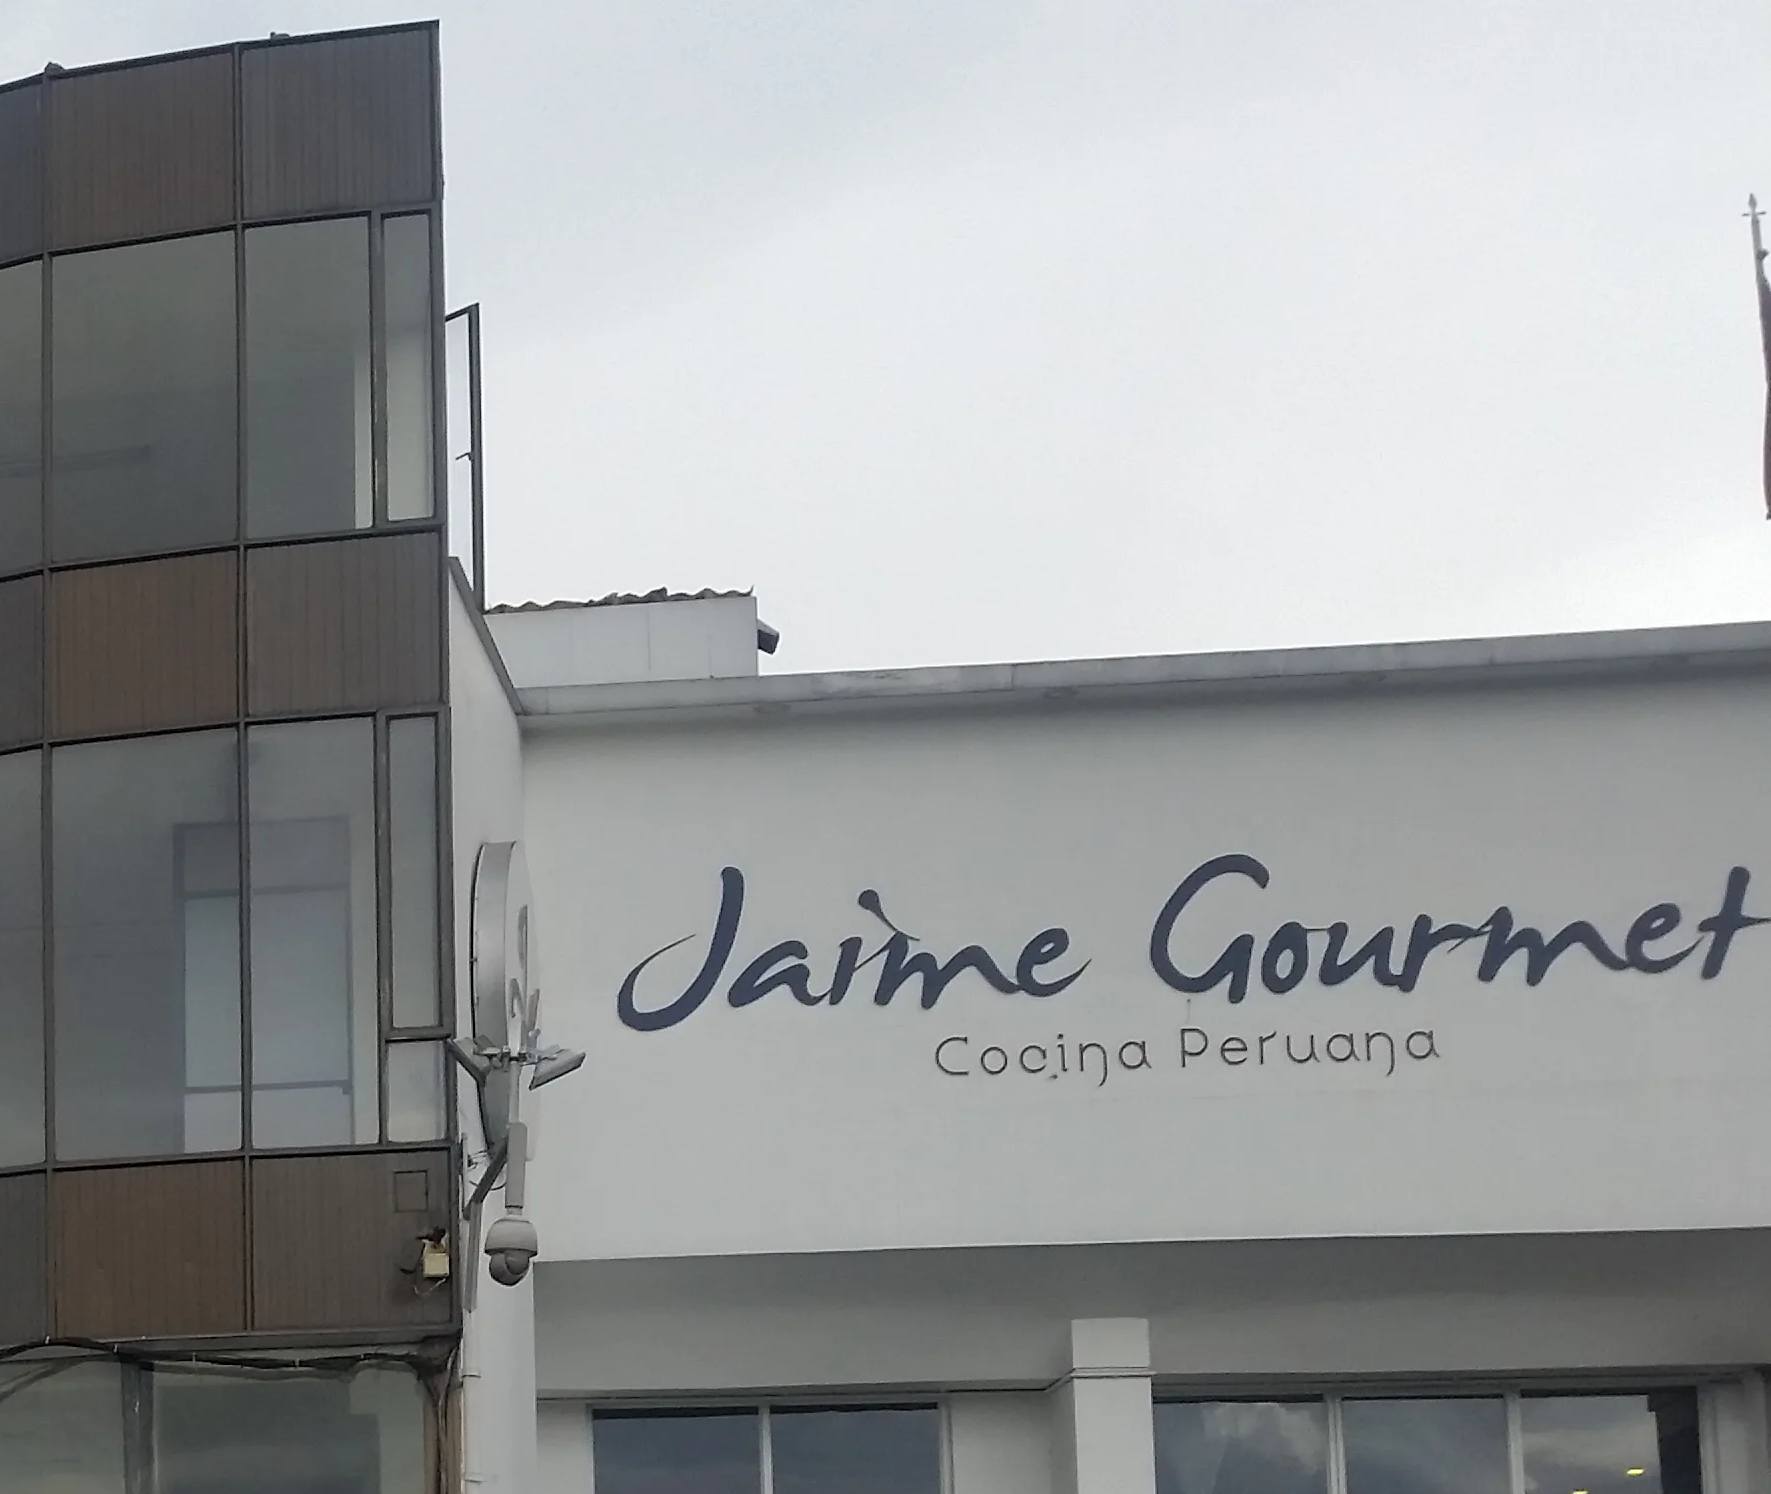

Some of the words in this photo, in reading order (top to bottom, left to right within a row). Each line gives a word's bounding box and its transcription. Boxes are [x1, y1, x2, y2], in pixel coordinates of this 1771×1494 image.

[616, 865, 1093, 1032] Jaime
[1150, 853, 1771, 1003] Gourmet
[935, 1033, 1152, 1087] Cocina
[1179, 1027, 1440, 1076] Peruana
